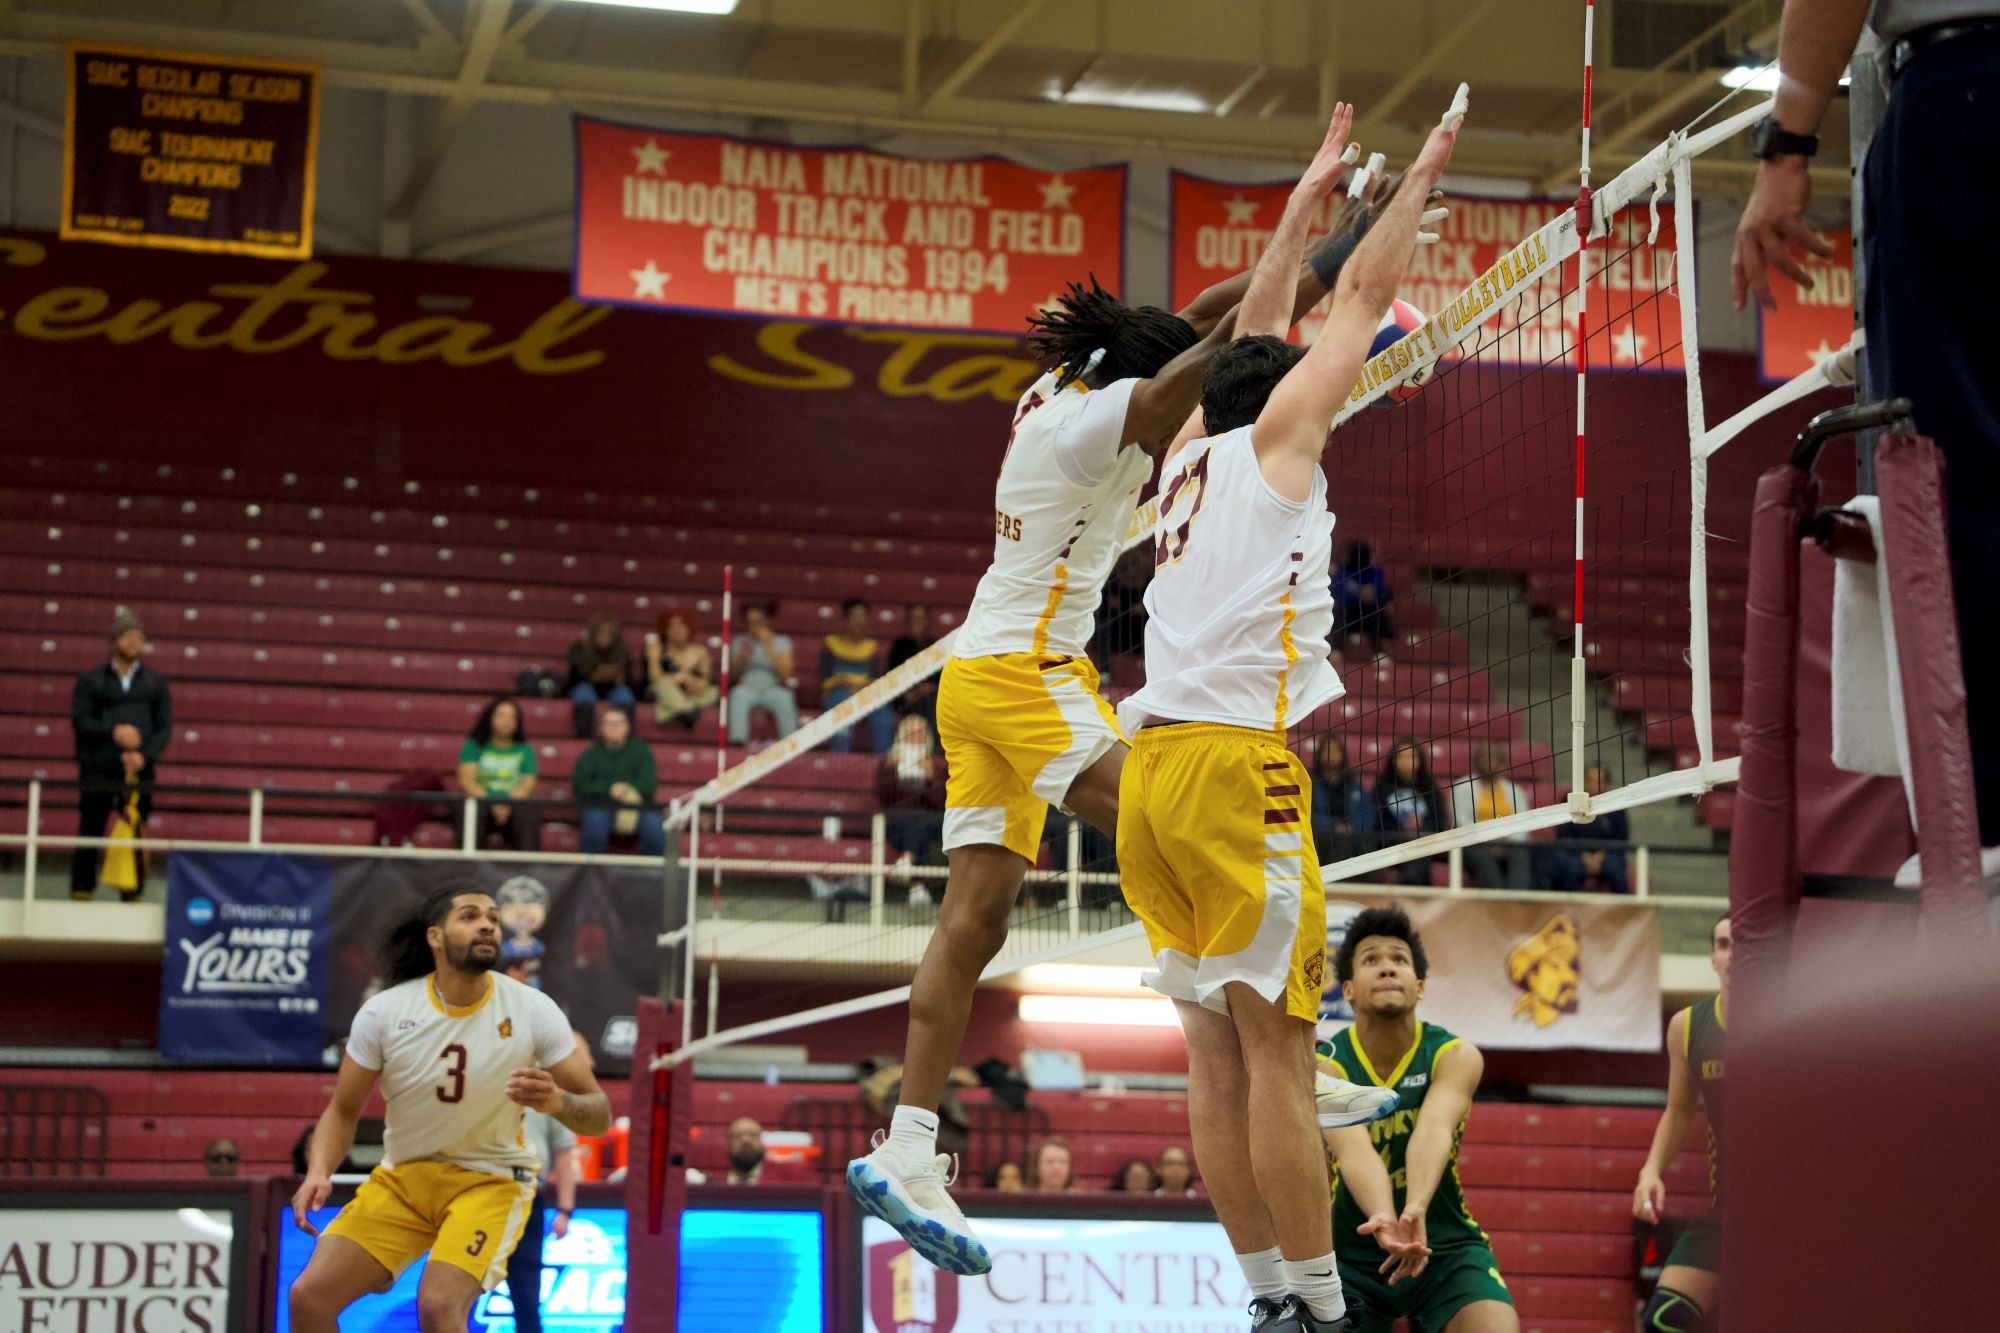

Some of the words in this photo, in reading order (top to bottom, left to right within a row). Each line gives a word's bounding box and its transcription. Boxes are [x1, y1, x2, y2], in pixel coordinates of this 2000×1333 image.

[141, 93, 243, 125] CHAMPIONS
[141, 157, 242, 189] CHAMPIONS
[160, 132, 275, 165] TOURNAMENT
[720, 142, 807, 193] NAIA
[822, 153, 990, 208] NATIONAL
[623, 175, 757, 231] INDOOR
[773, 192, 889, 243] TRACK
[902, 204, 975, 249] AND
[988, 208, 1084, 257] FIELD
[703, 228, 910, 288] CHAMPIONS
[923, 249, 1009, 294] 1994
[1438, 232, 1548, 339] VOLLEYBALL
[733, 275, 829, 317] MEN'S
[837, 284, 974, 328] PROGRAM
[228, 927, 290, 946] MAKE
[435, 1043, 468, 1104] 3
[465, 1229, 488, 1257] 3
[986, 1248, 1248, 1307] CENTR
